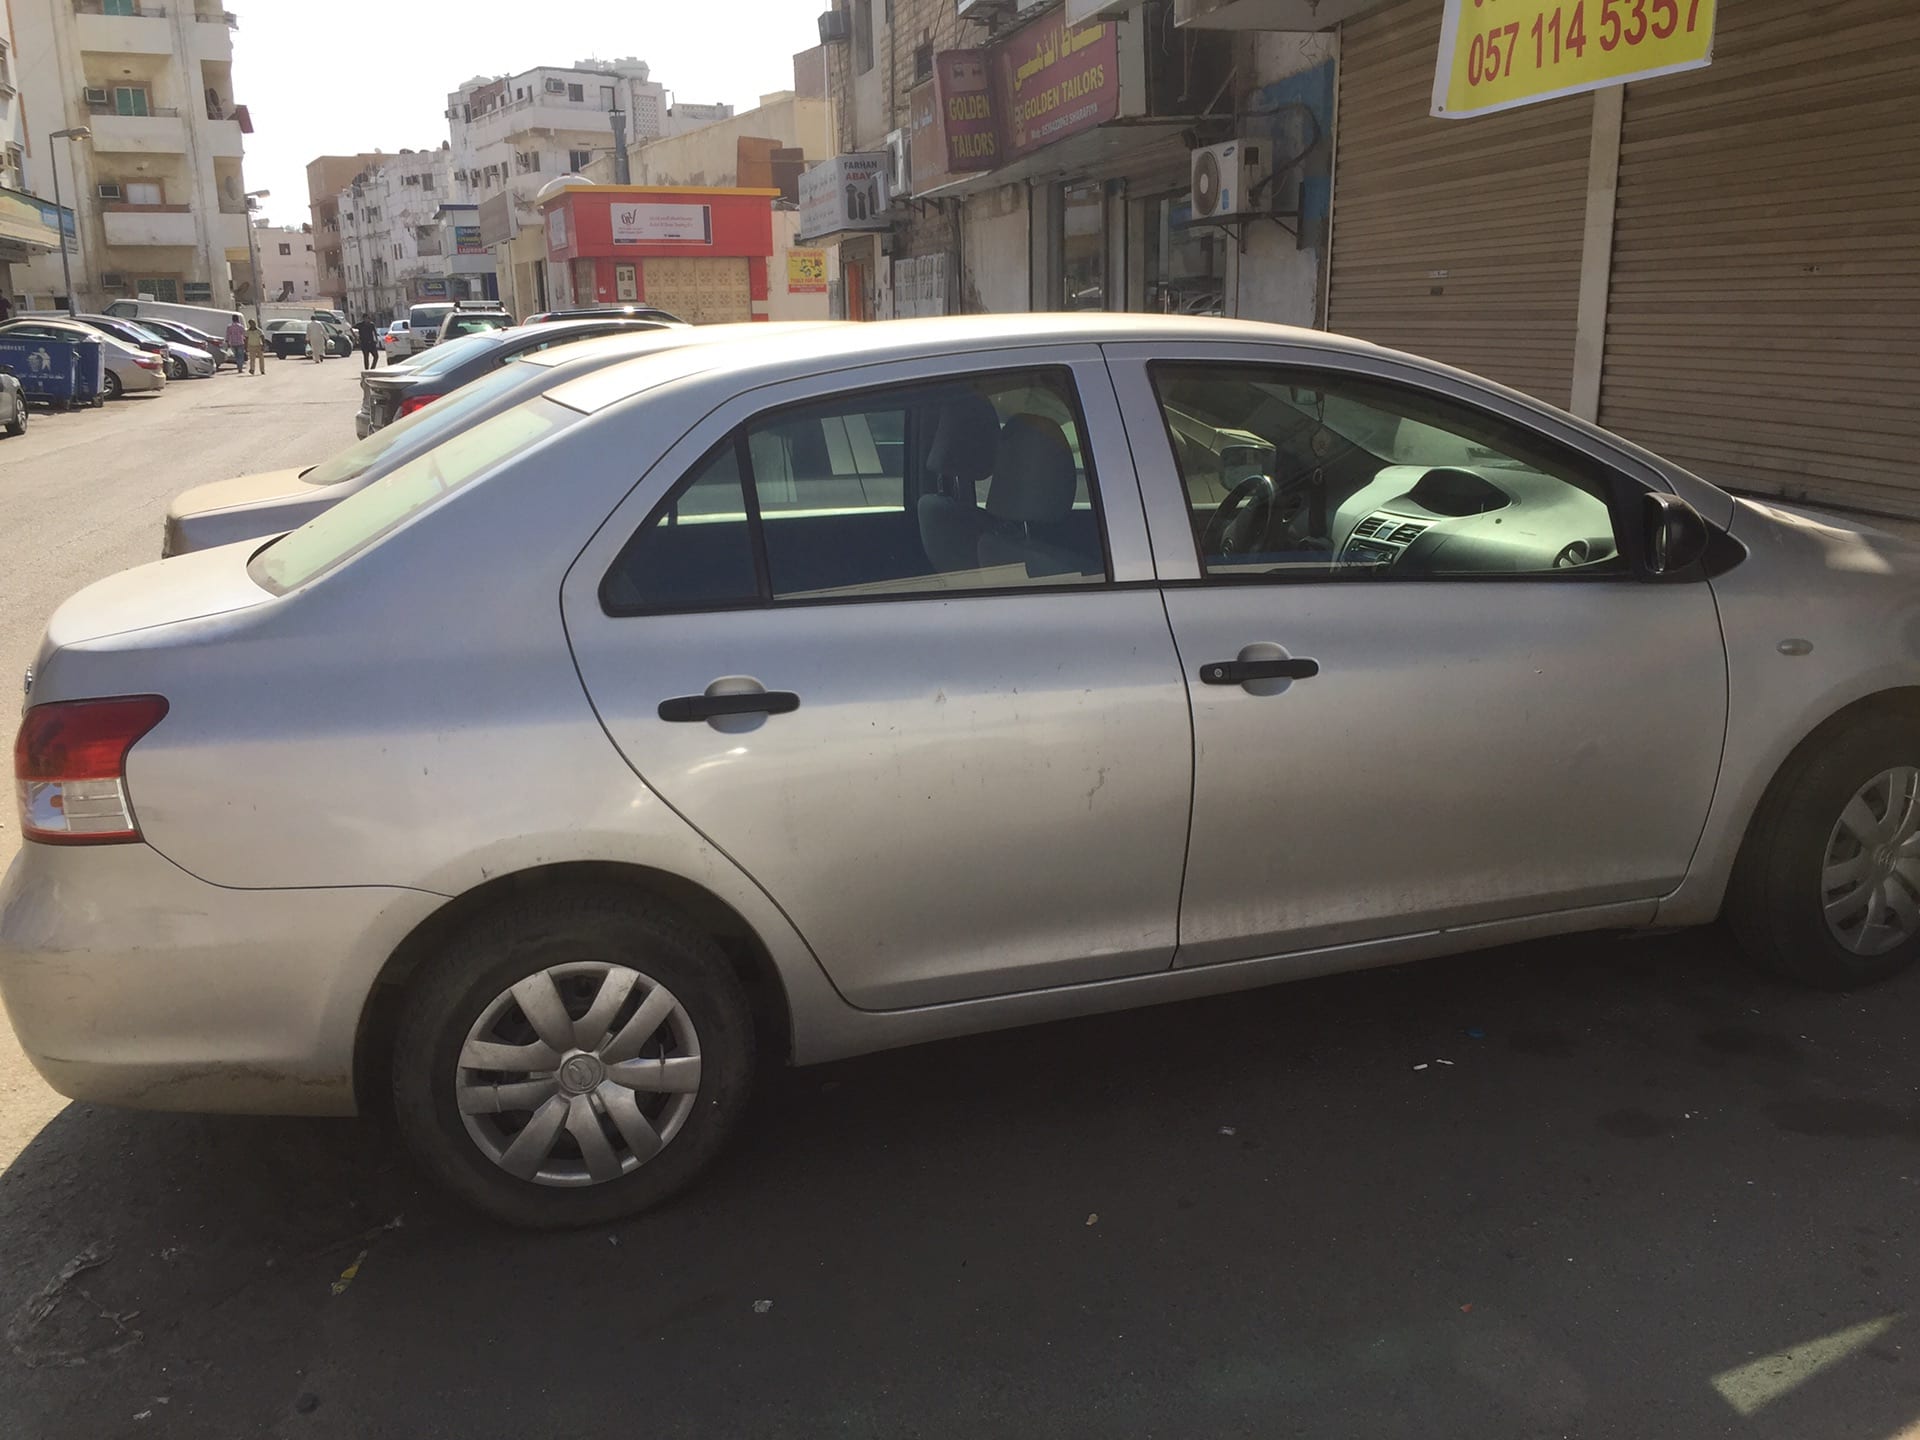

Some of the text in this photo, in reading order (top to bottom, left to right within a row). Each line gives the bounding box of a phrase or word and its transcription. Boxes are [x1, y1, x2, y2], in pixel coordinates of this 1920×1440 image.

[1468, 0, 1700, 86] 057 114 5357
[1024, 63, 1104, 121] GOLDEN TAILORS
[949, 95, 991, 121] GOLDEN
[951, 131, 995, 159] TAILORS
[843, 160, 878, 170] FARHAN
[846, 171, 872, 180] ABAY
